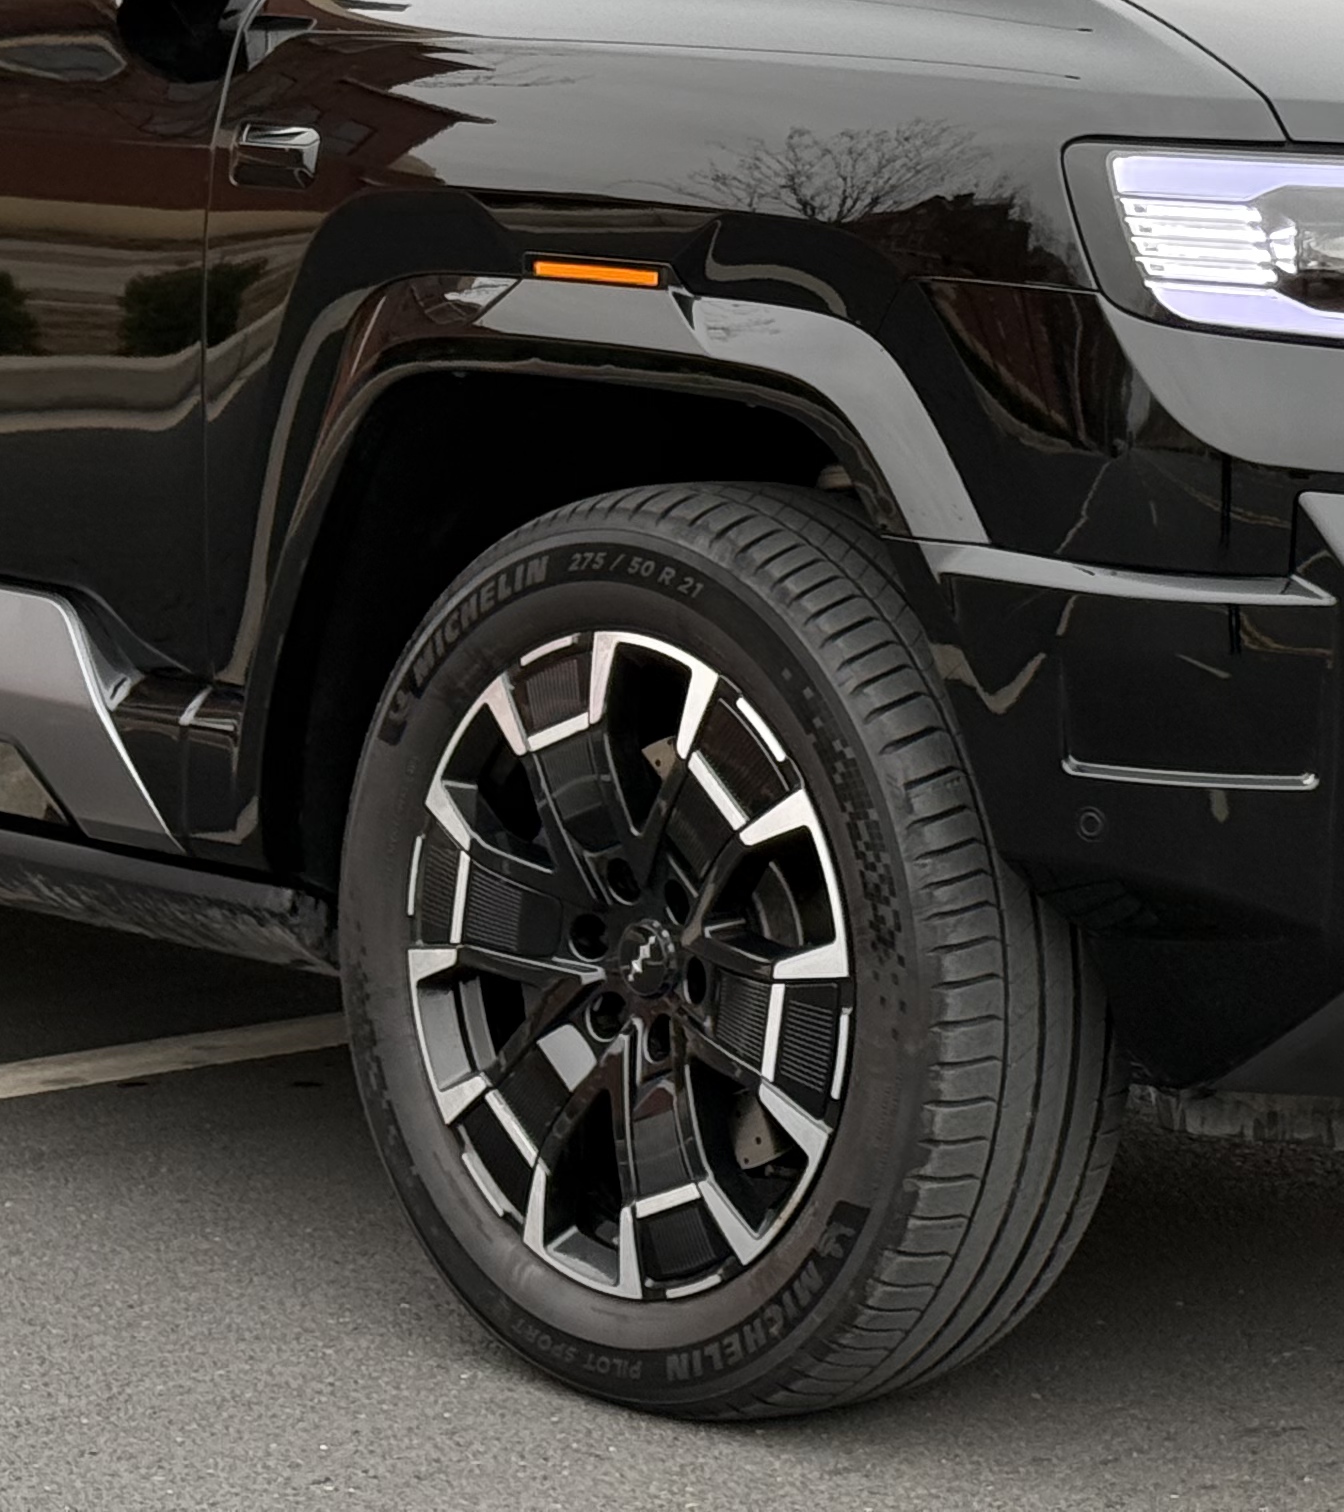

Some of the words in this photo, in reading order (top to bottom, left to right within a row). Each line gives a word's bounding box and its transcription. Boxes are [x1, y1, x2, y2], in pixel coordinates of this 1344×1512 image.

[413, 555, 550, 688] MICHELIN
[567, 551, 608, 572] 275
[658, 566, 677, 586] R
[677, 576, 705, 598] 21
[510, 1317, 579, 1362] SPORT
[665, 1261, 824, 1381] MICHELIN
[584, 1352, 642, 1380] PILOT
